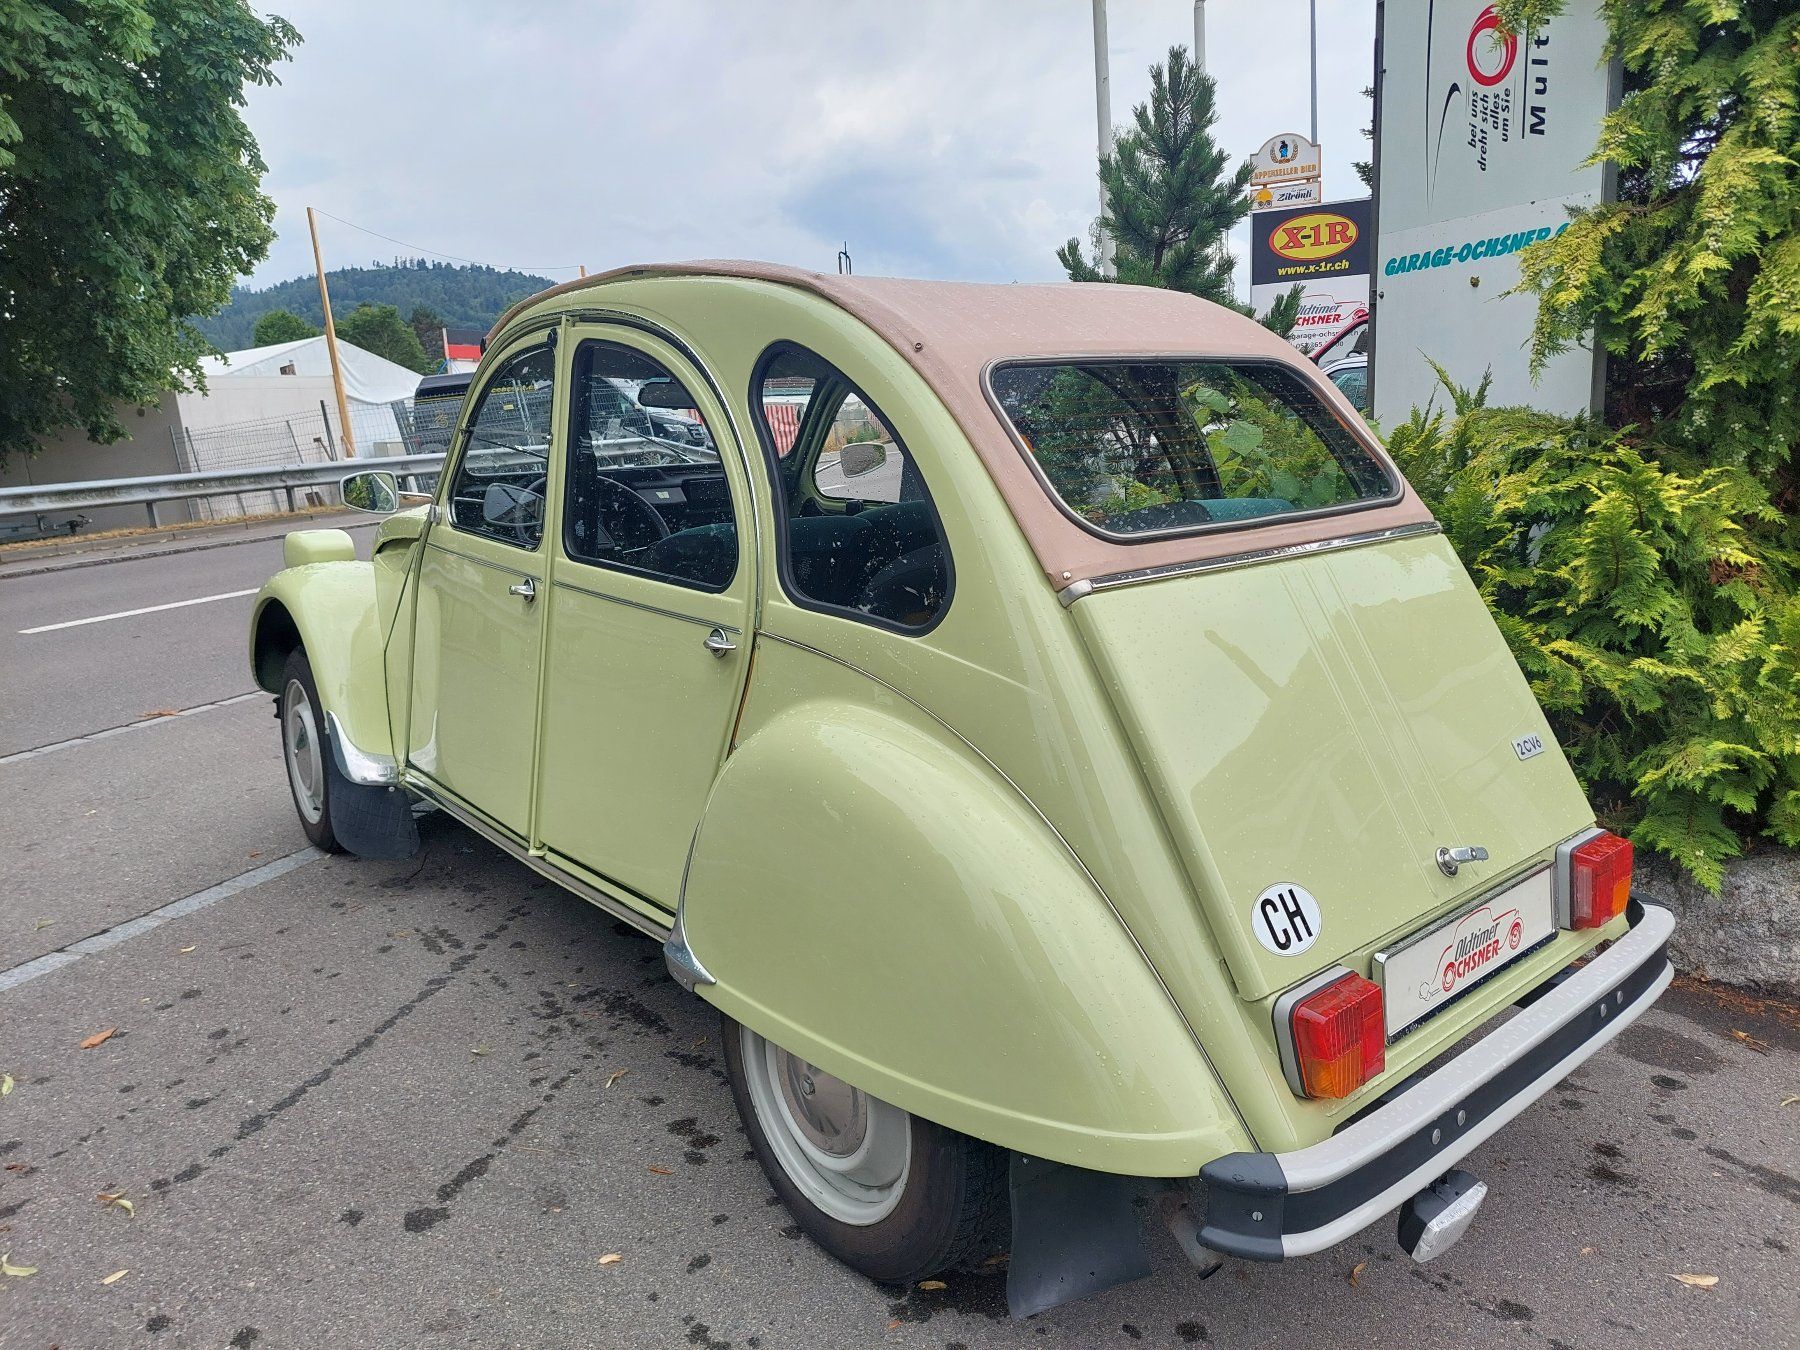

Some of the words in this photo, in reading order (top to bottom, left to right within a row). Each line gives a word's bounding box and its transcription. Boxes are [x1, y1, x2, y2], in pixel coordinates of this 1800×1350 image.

[1471, 90, 1479, 119] uns
[1480, 93, 1489, 124] sich
[1490, 92, 1500, 130] alles
[1501, 88, 1511, 114] Sie
[1468, 123, 1477, 149] bei
[1501, 118, 1509, 142] um
[1477, 129, 1488, 171] dreht
[1300, 164, 1317, 174] BIER
[1280, 221, 1354, 250] X-1R
[1277, 259, 1350, 276] www.x-1r.ch
[1516, 735, 1542, 756] 2CV6
[1260, 887, 1314, 951] CH
[1454, 921, 1501, 962] Oldtimer
[1441, 938, 1501, 993] OCHSNER
